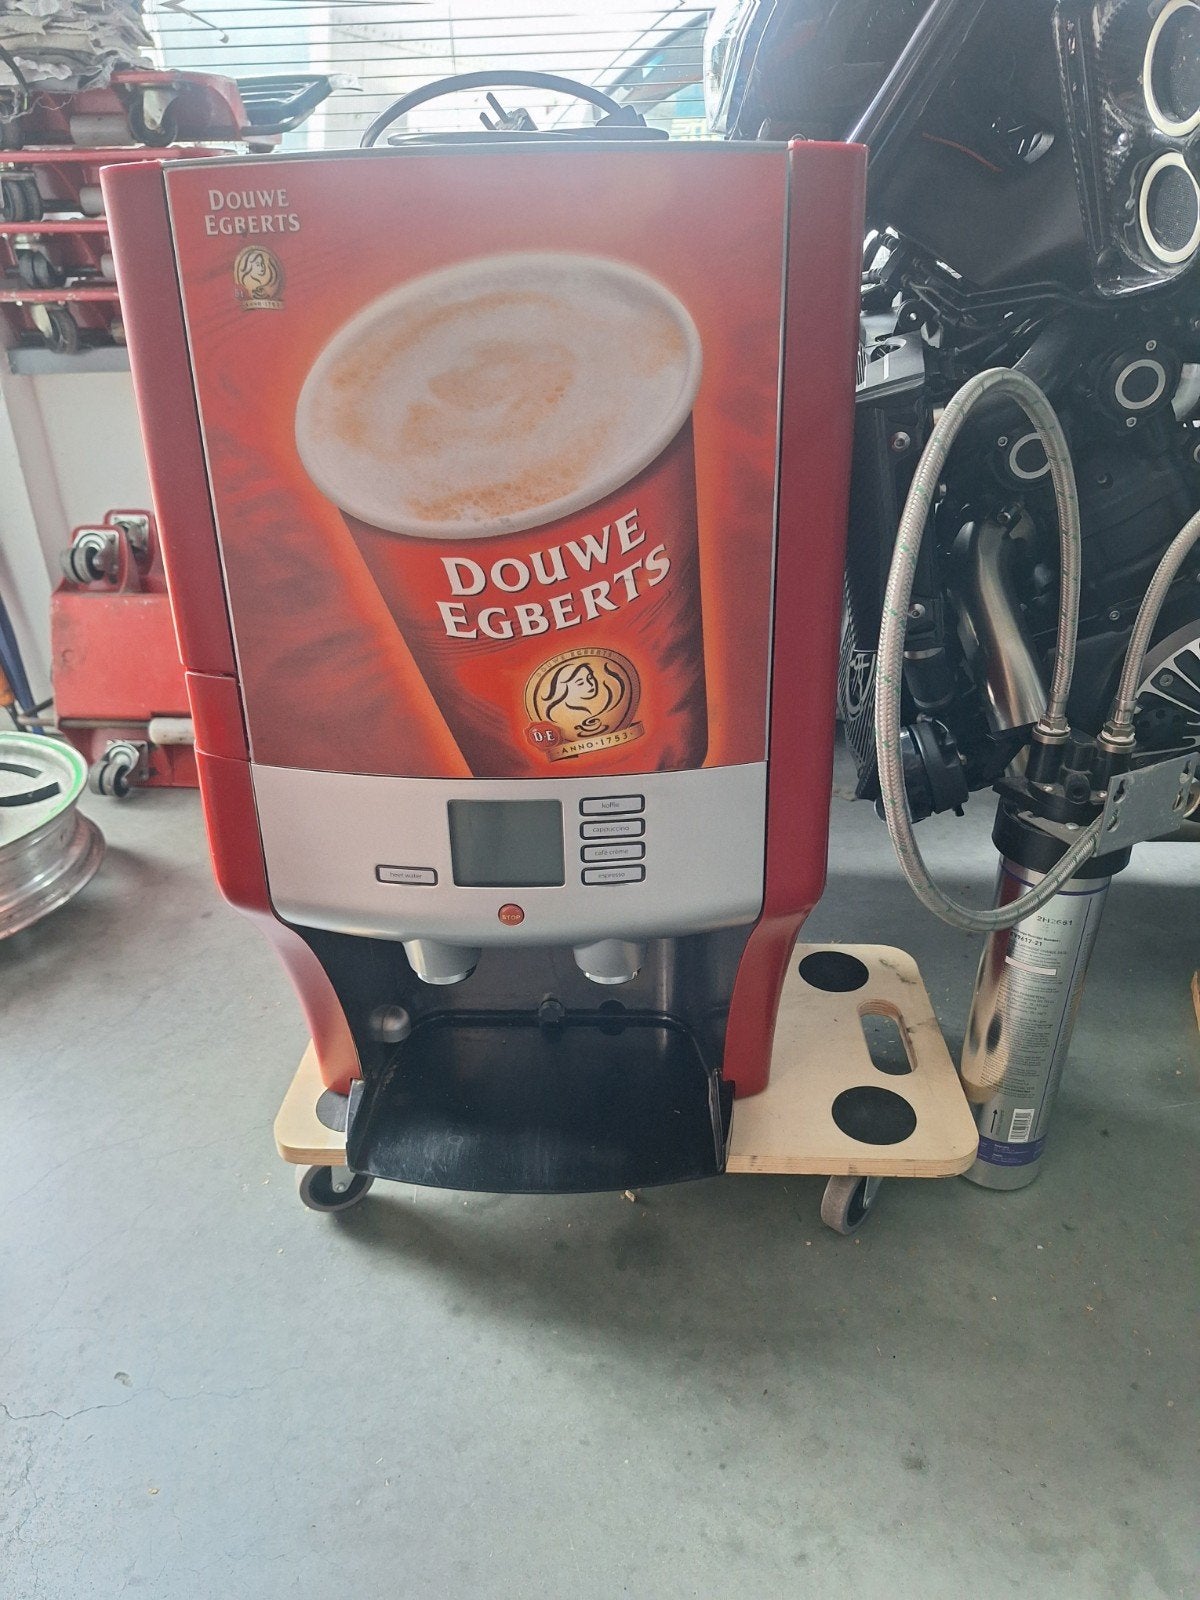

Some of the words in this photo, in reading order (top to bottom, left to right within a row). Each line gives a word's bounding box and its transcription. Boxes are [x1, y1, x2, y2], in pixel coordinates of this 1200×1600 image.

[208, 188, 290, 211] DOUWE
[204, 213, 301, 236] EGBERTS
[440, 508, 646, 597] DOUWE
[435, 544, 671, 640] EGBERTS
[601, 801, 620, 809] koffie
[592, 825, 630, 834] cappuccino
[598, 871, 626, 880] espresso
[501, 913, 521, 921] STOP
